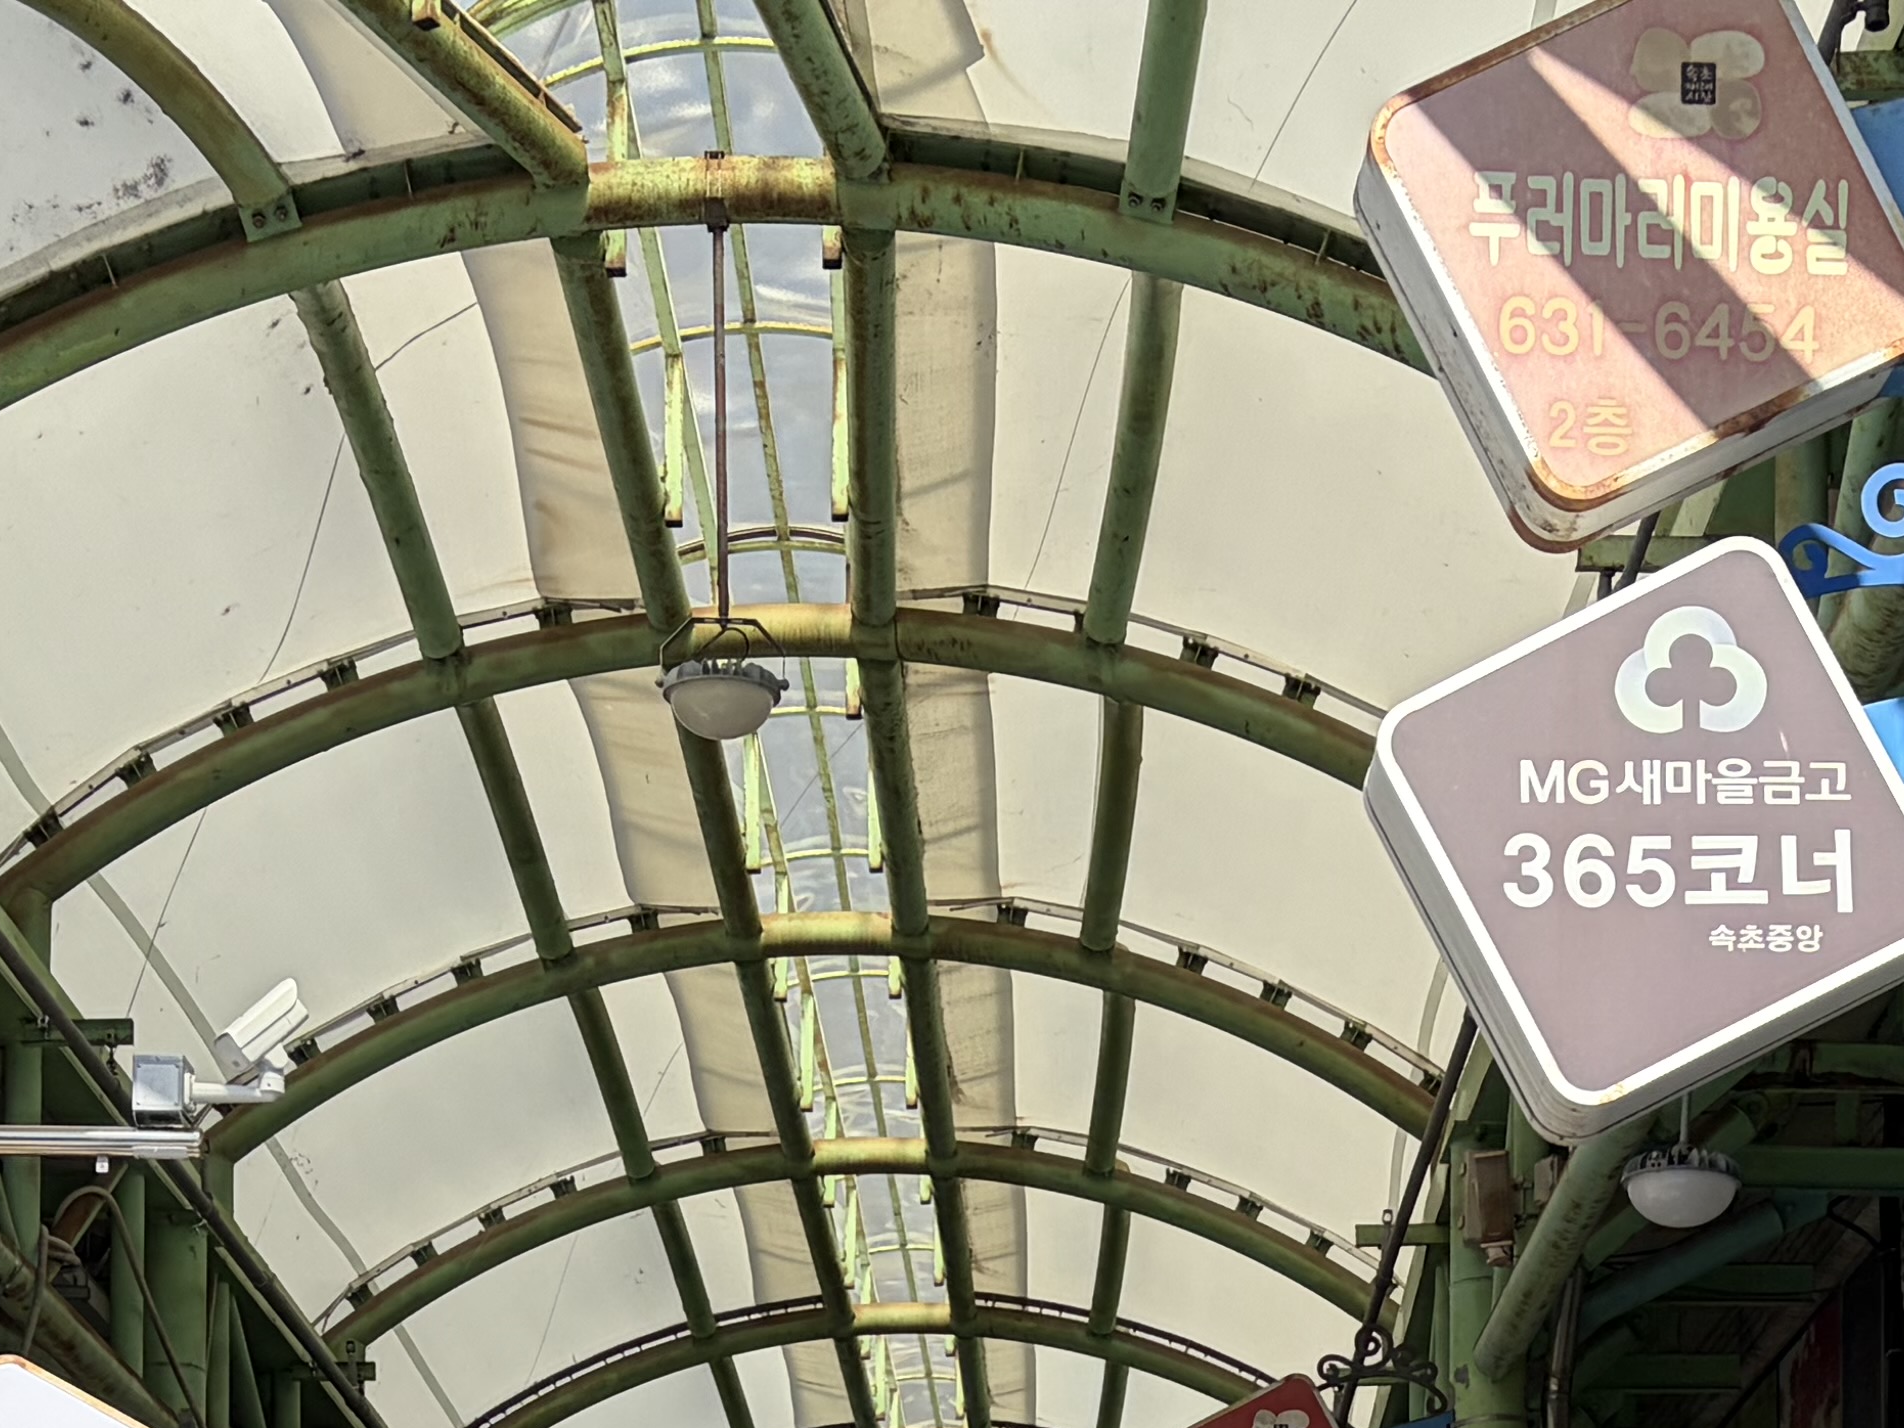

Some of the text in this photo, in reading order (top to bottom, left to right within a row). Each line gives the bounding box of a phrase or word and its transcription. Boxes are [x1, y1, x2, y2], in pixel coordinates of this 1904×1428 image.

[1469, 170, 1850, 276] 푸러마러미용실
[1499, 297, 1820, 364] 631-6454
[1548, 397, 1634, 456] 2층
[1519, 759, 1852, 806] MG새마을금고
[1503, 829, 1853, 913] 365코너
[1708, 925, 1823, 953] 속초중앙
